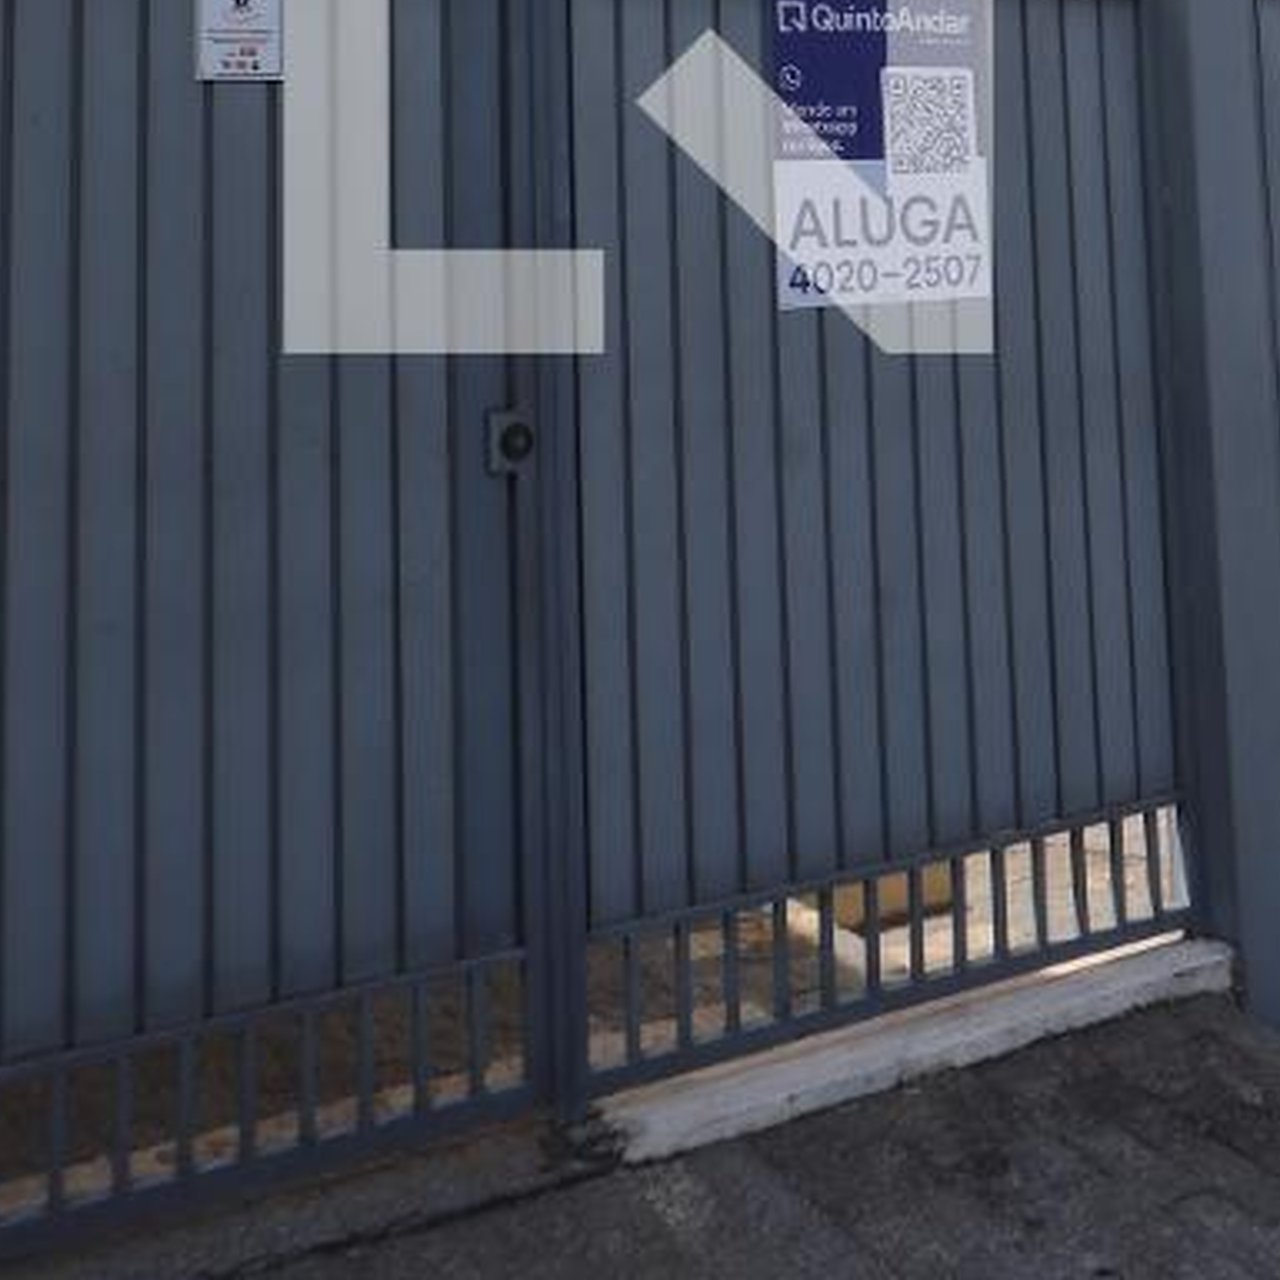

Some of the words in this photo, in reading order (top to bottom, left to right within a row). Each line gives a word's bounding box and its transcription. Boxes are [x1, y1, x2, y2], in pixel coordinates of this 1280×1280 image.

[811, 3, 970, 35] QuintoAndar
[789, 192, 980, 250] ALUGA
[788, 254, 982, 295] 4020-2507
